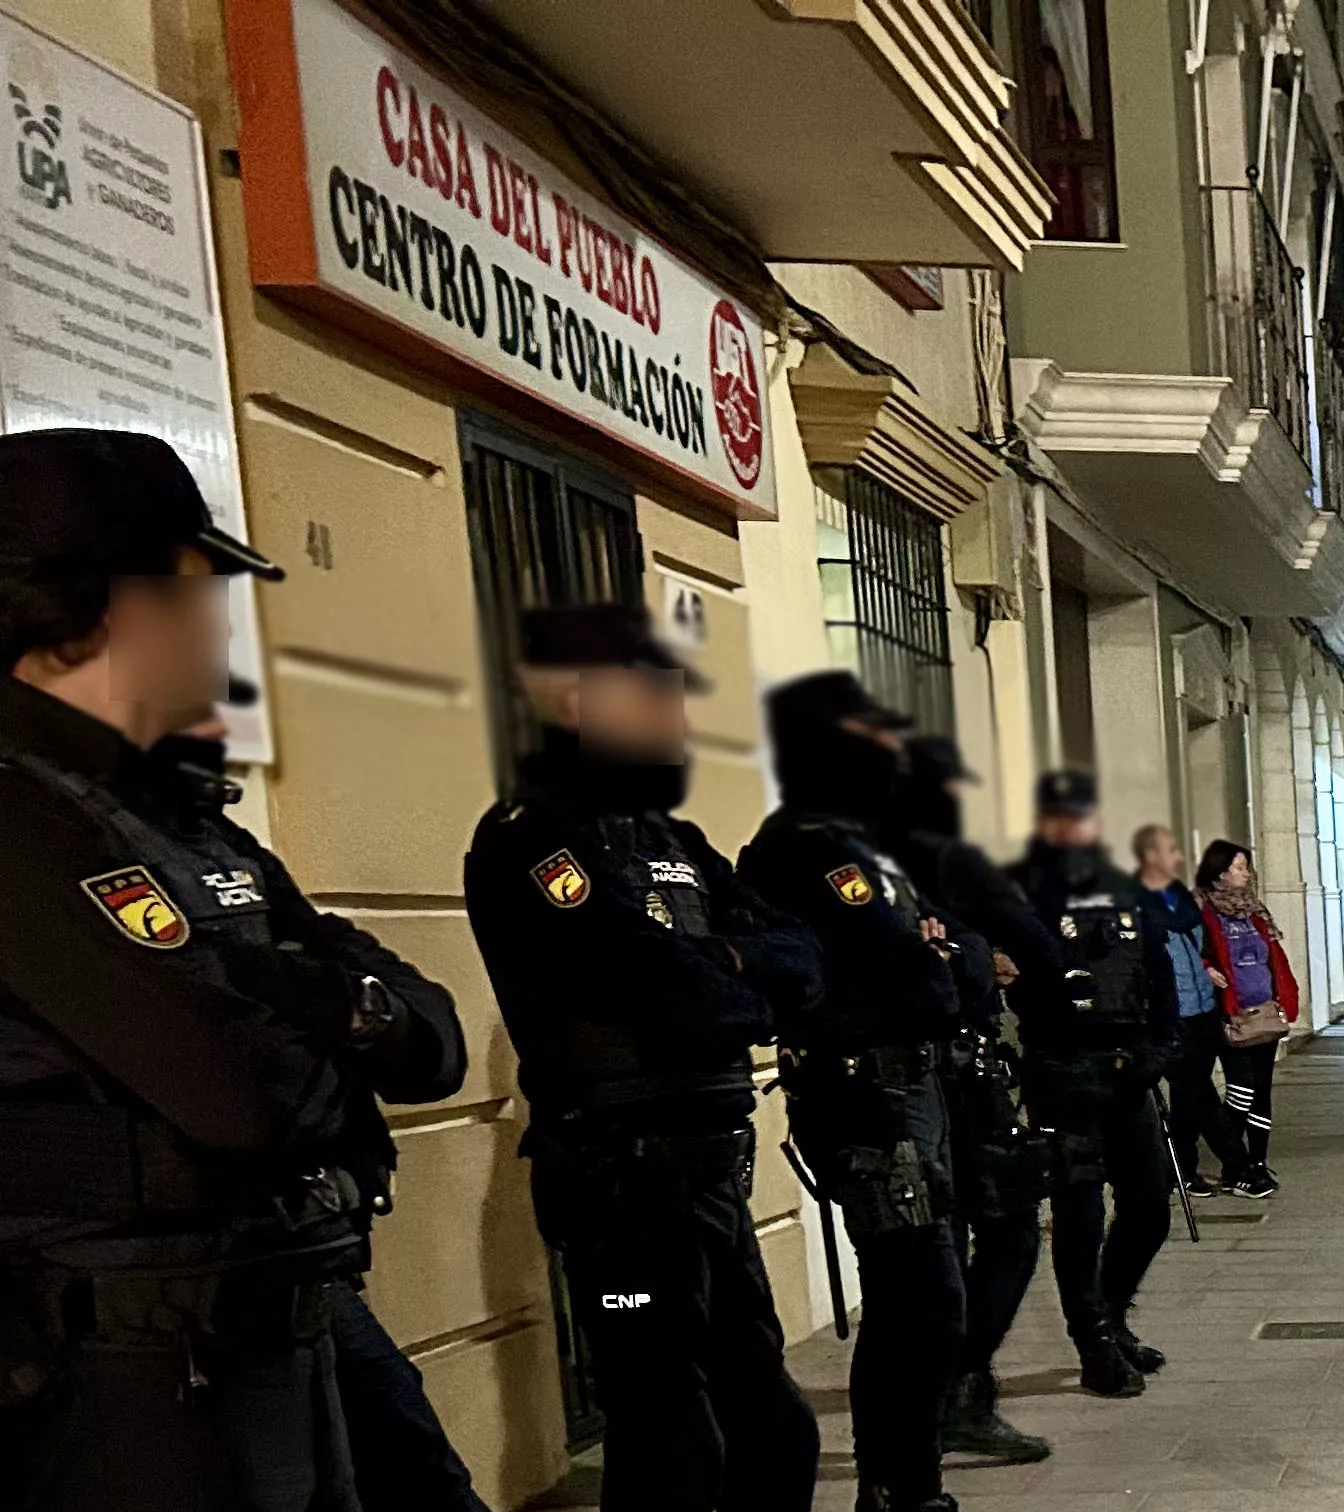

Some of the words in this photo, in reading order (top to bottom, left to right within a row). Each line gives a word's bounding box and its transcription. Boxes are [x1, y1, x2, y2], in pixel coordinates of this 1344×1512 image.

[329, 166, 486, 338] CENTRO
[491, 263, 542, 370] DE
[543, 293, 708, 459] FORMACIÓN
[376, 65, 482, 219] CASA
[483, 143, 552, 266] DEL
[552, 191, 661, 335] PUEBLO
[602, 1293, 651, 1309] CNP
